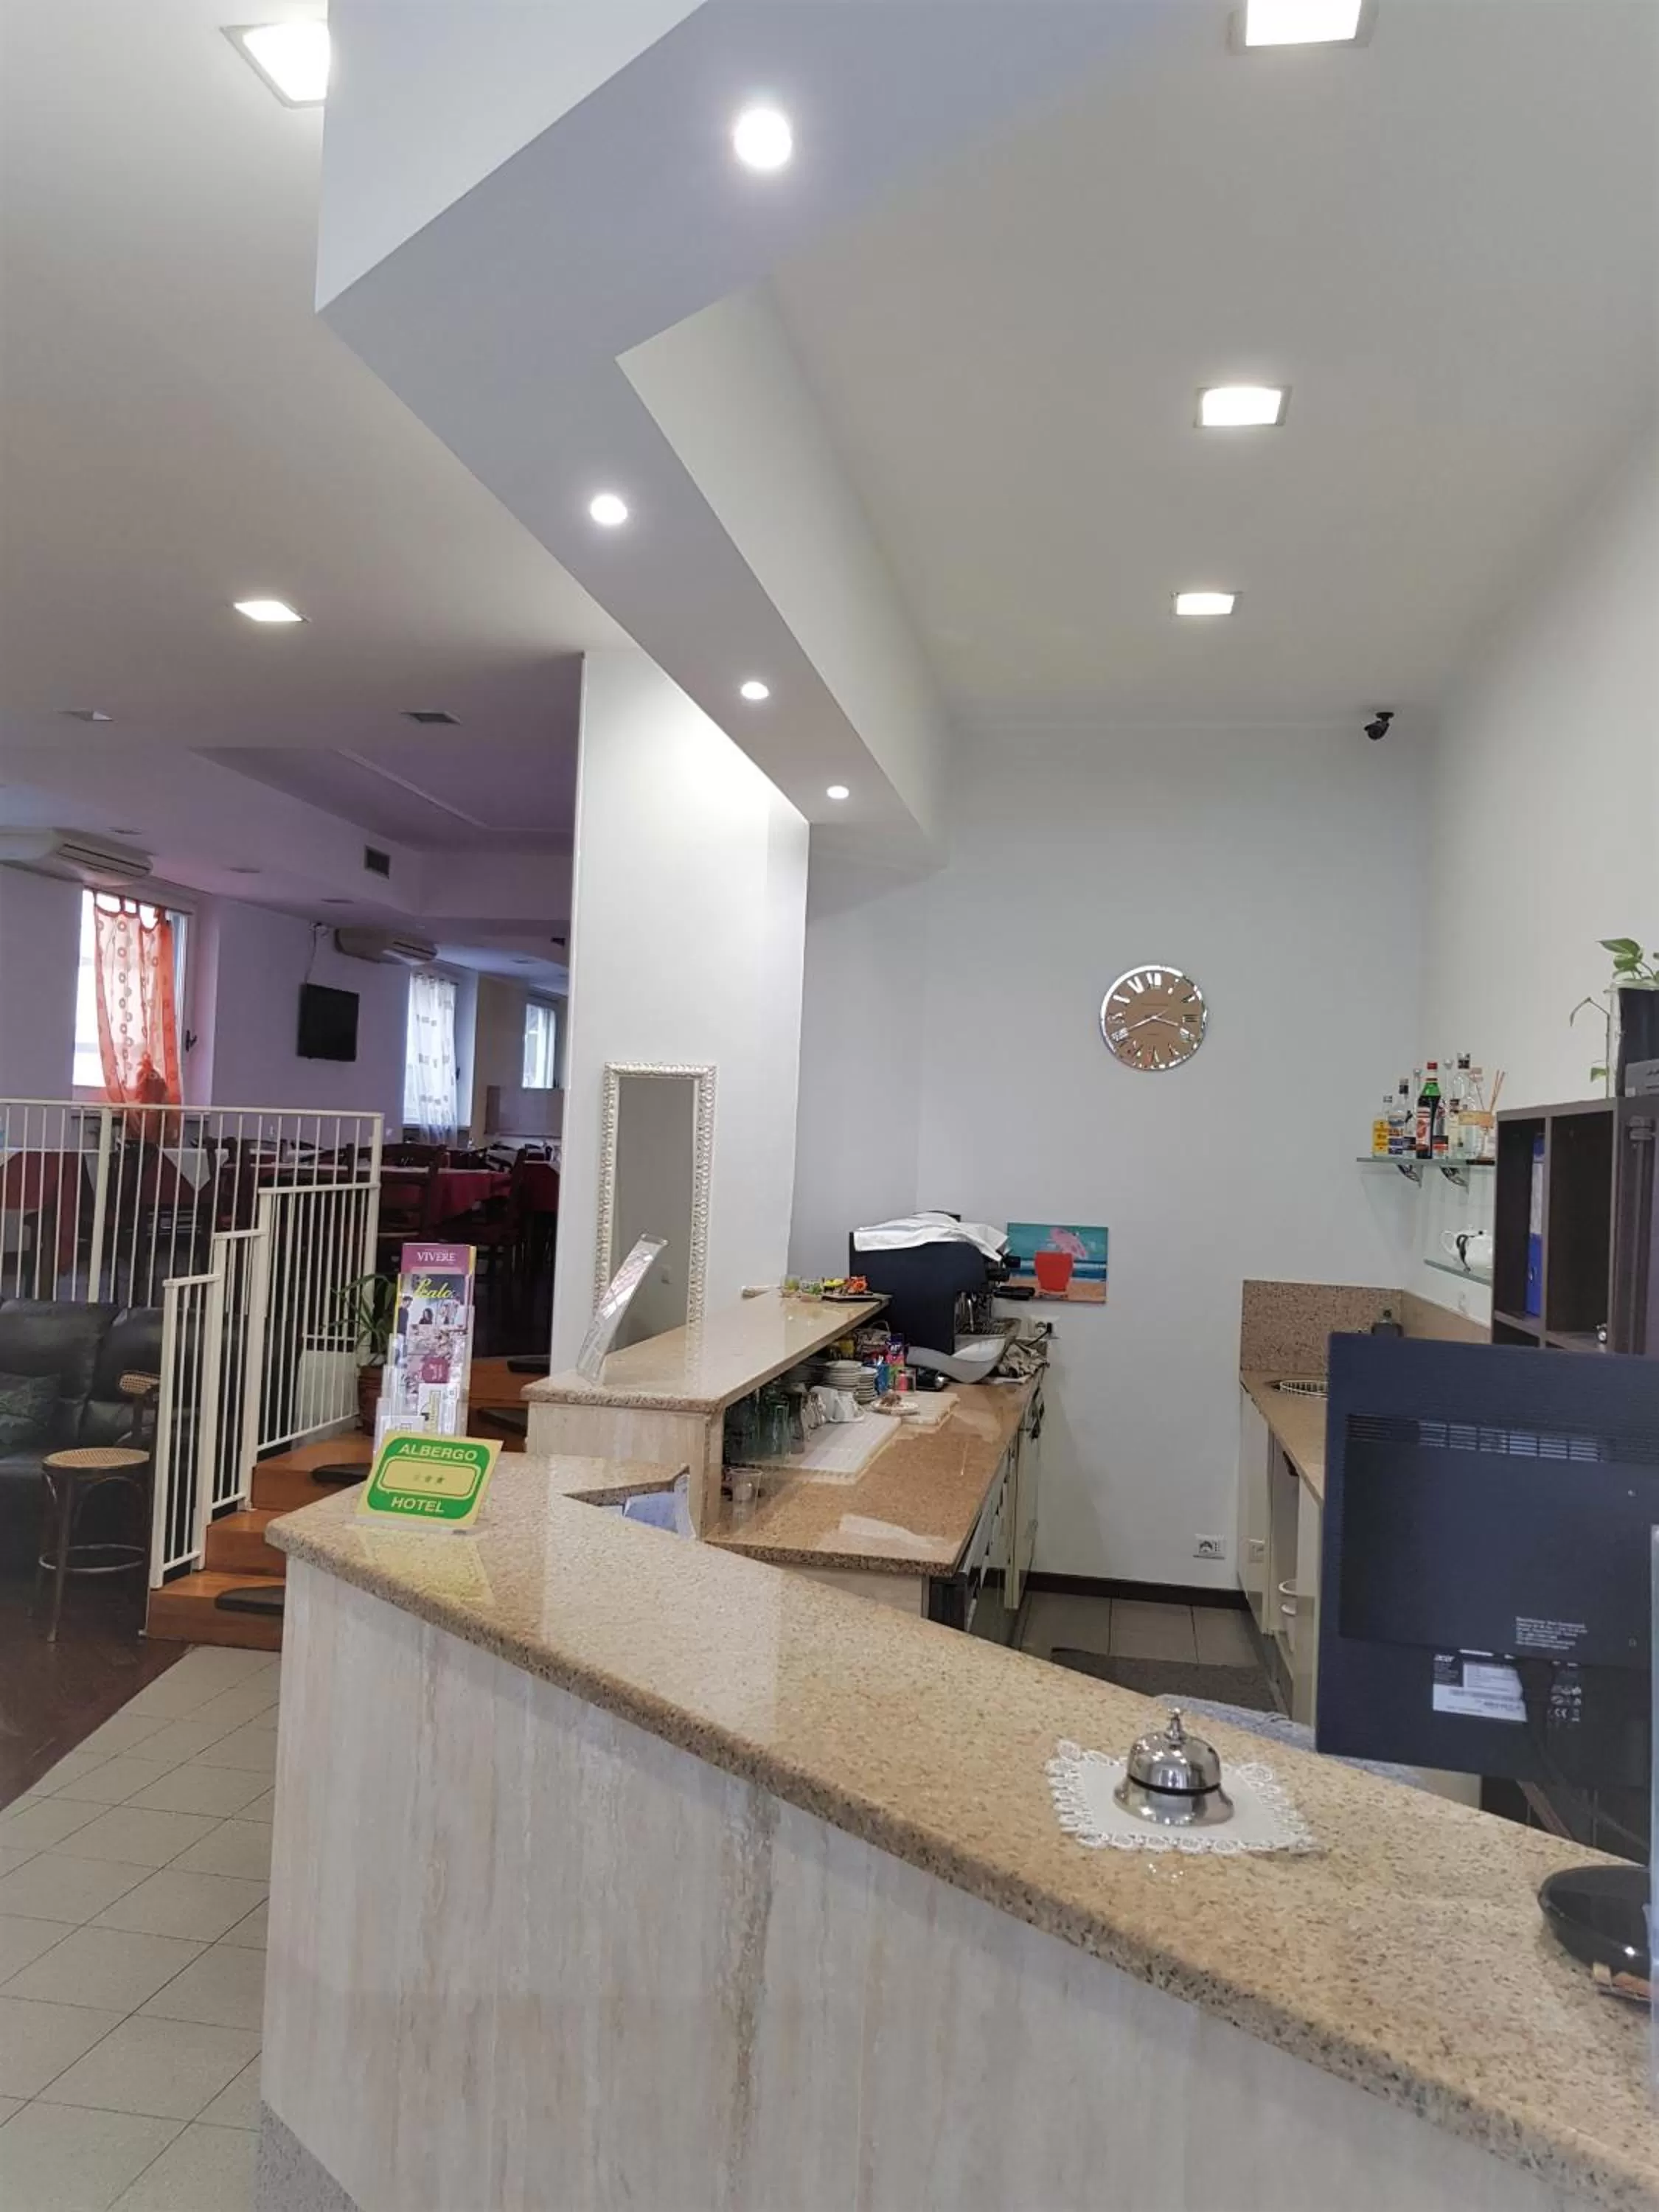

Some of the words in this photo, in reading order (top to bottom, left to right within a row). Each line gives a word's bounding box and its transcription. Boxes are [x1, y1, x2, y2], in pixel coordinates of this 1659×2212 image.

[417, 1251, 456, 1262] VIVERE
[399, 1443, 479, 1462] ALBERGO
[391, 1496, 445, 1513] HOTEL
